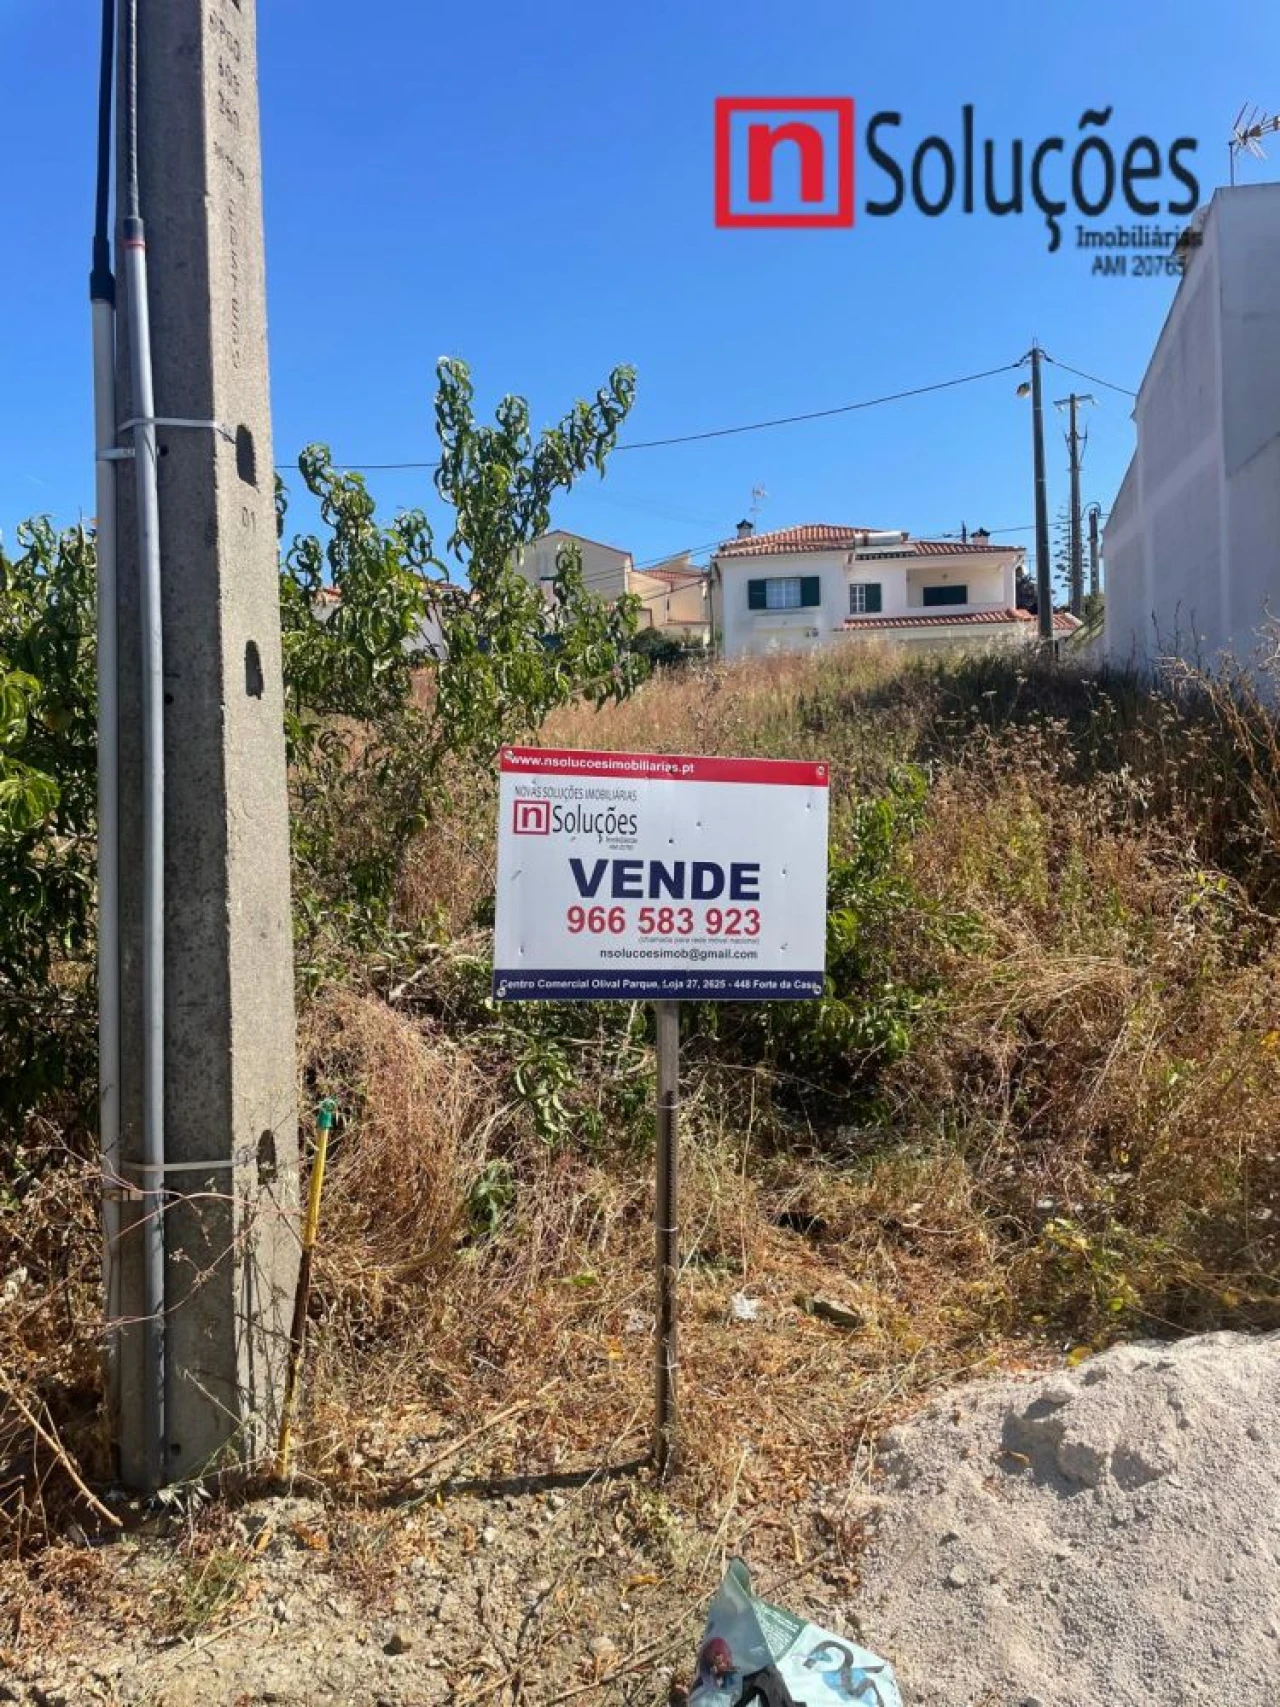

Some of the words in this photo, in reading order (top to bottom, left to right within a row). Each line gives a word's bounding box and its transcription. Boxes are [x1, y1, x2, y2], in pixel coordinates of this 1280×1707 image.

[515, 786, 542, 798] NOVAS
[543, 785, 584, 802] SOLUÇÕES
[552, 803, 638, 844] Soluções
[568, 858, 761, 901] VENDE
[567, 905, 626, 935] 966
[637, 907, 695, 935] 583
[706, 908, 761, 936] 923
[600, 948, 758, 962] nsolucoesimob@gmail.com
[500, 979, 535, 989] Centro
[537, 979, 590, 989] Comercial
[591, 979, 620, 989] Olival
[661, 979, 684, 991] Loja
[753, 979, 778, 989] Forte
[780, 979, 792, 989] da
